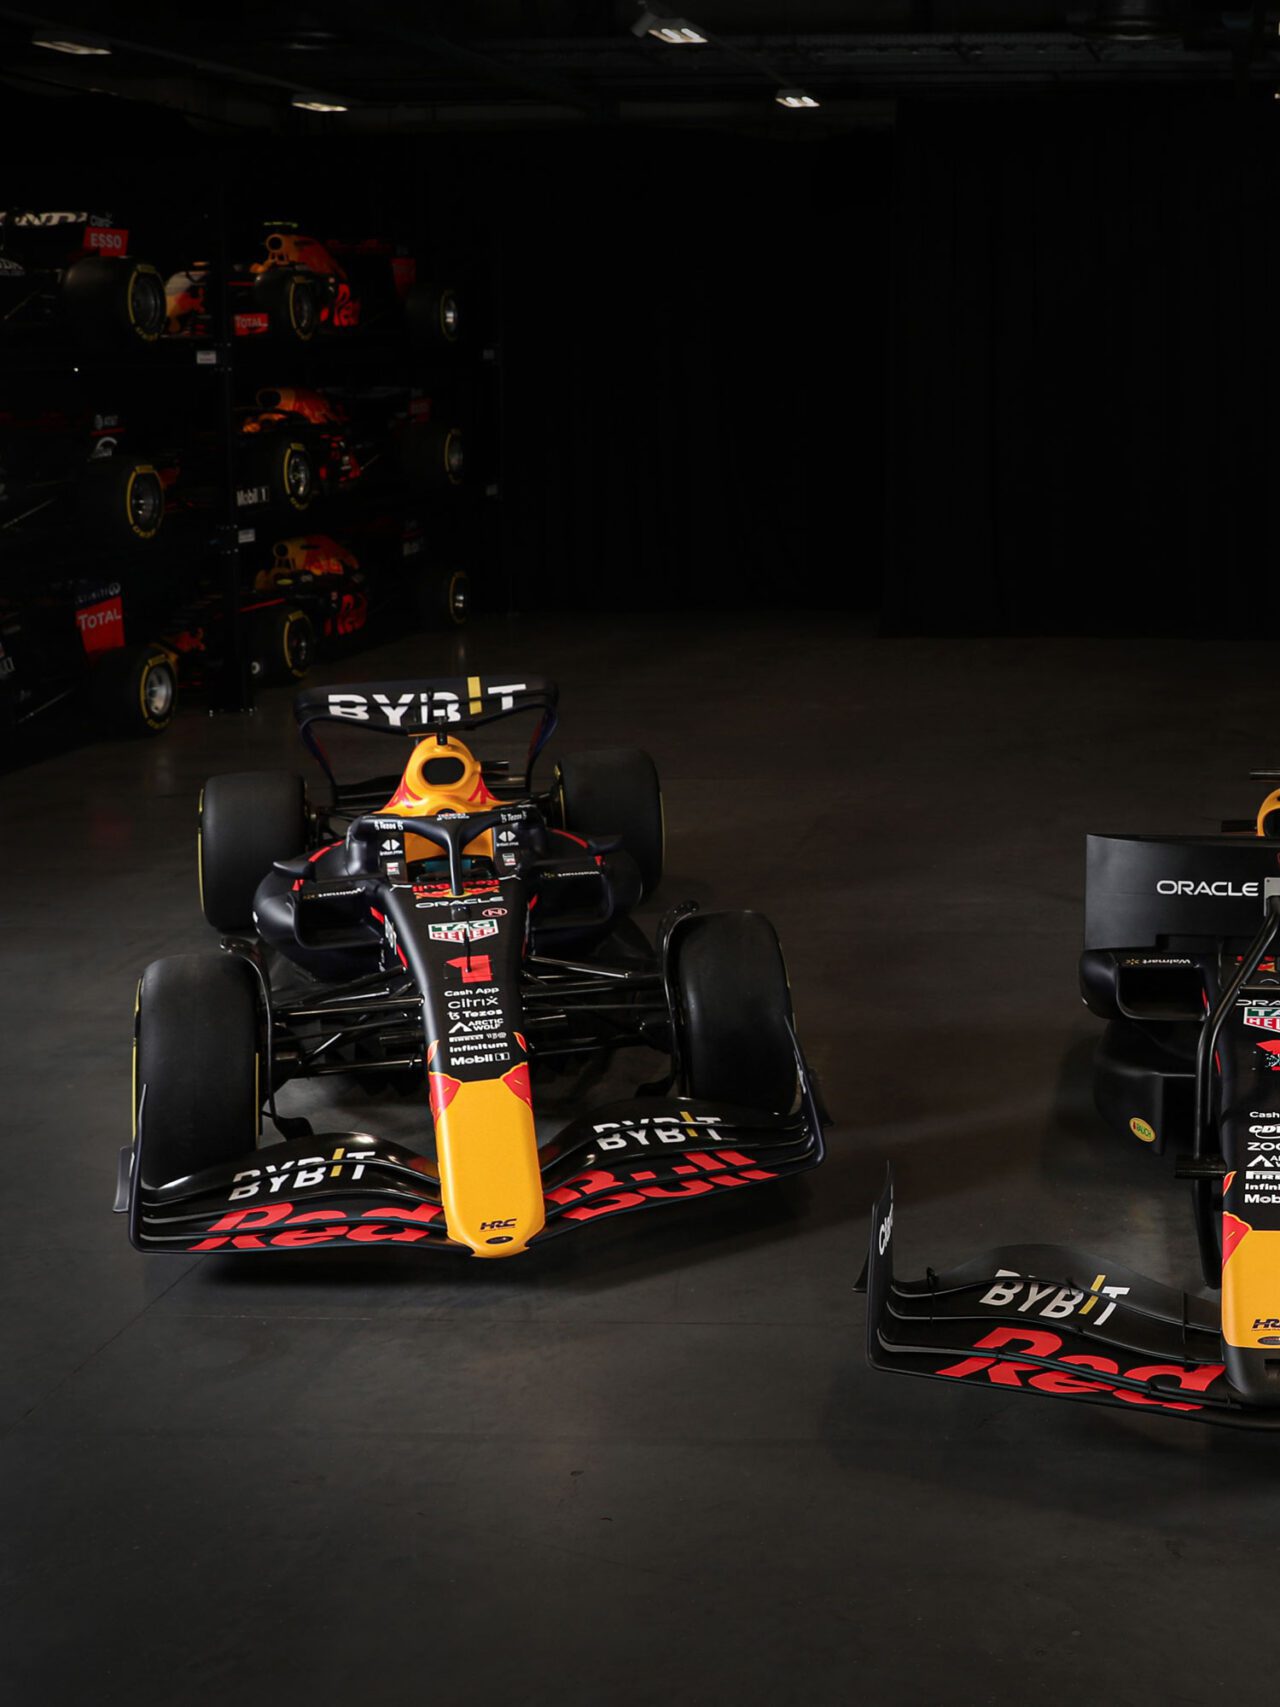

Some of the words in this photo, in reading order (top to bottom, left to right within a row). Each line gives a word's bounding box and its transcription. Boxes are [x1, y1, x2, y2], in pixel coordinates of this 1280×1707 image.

[89, 233, 122, 249] ESSO
[79, 608, 122, 631] TOTAL
[327, 676, 527, 726] BYBIT
[1157, 880, 1259, 897] ORACLE
[415, 896, 504, 909] ORACLE
[438, 920, 494, 933] TAG
[446, 954, 494, 984] 1
[462, 1008, 503, 1018] Tezos
[468, 1018, 504, 1027] ARCTIC
[450, 1053, 494, 1067] Mobil
[1249, 1111, 1280, 1119] Cash
[593, 1111, 723, 1151] BYBIT
[228, 1147, 377, 1201] BYBIT
[544, 1149, 780, 1221] Bull
[186, 1202, 444, 1251] Red
[480, 1218, 517, 1230] HRC
[979, 1269, 1130, 1326] BYBIT
[934, 1327, 1226, 1412] Red
